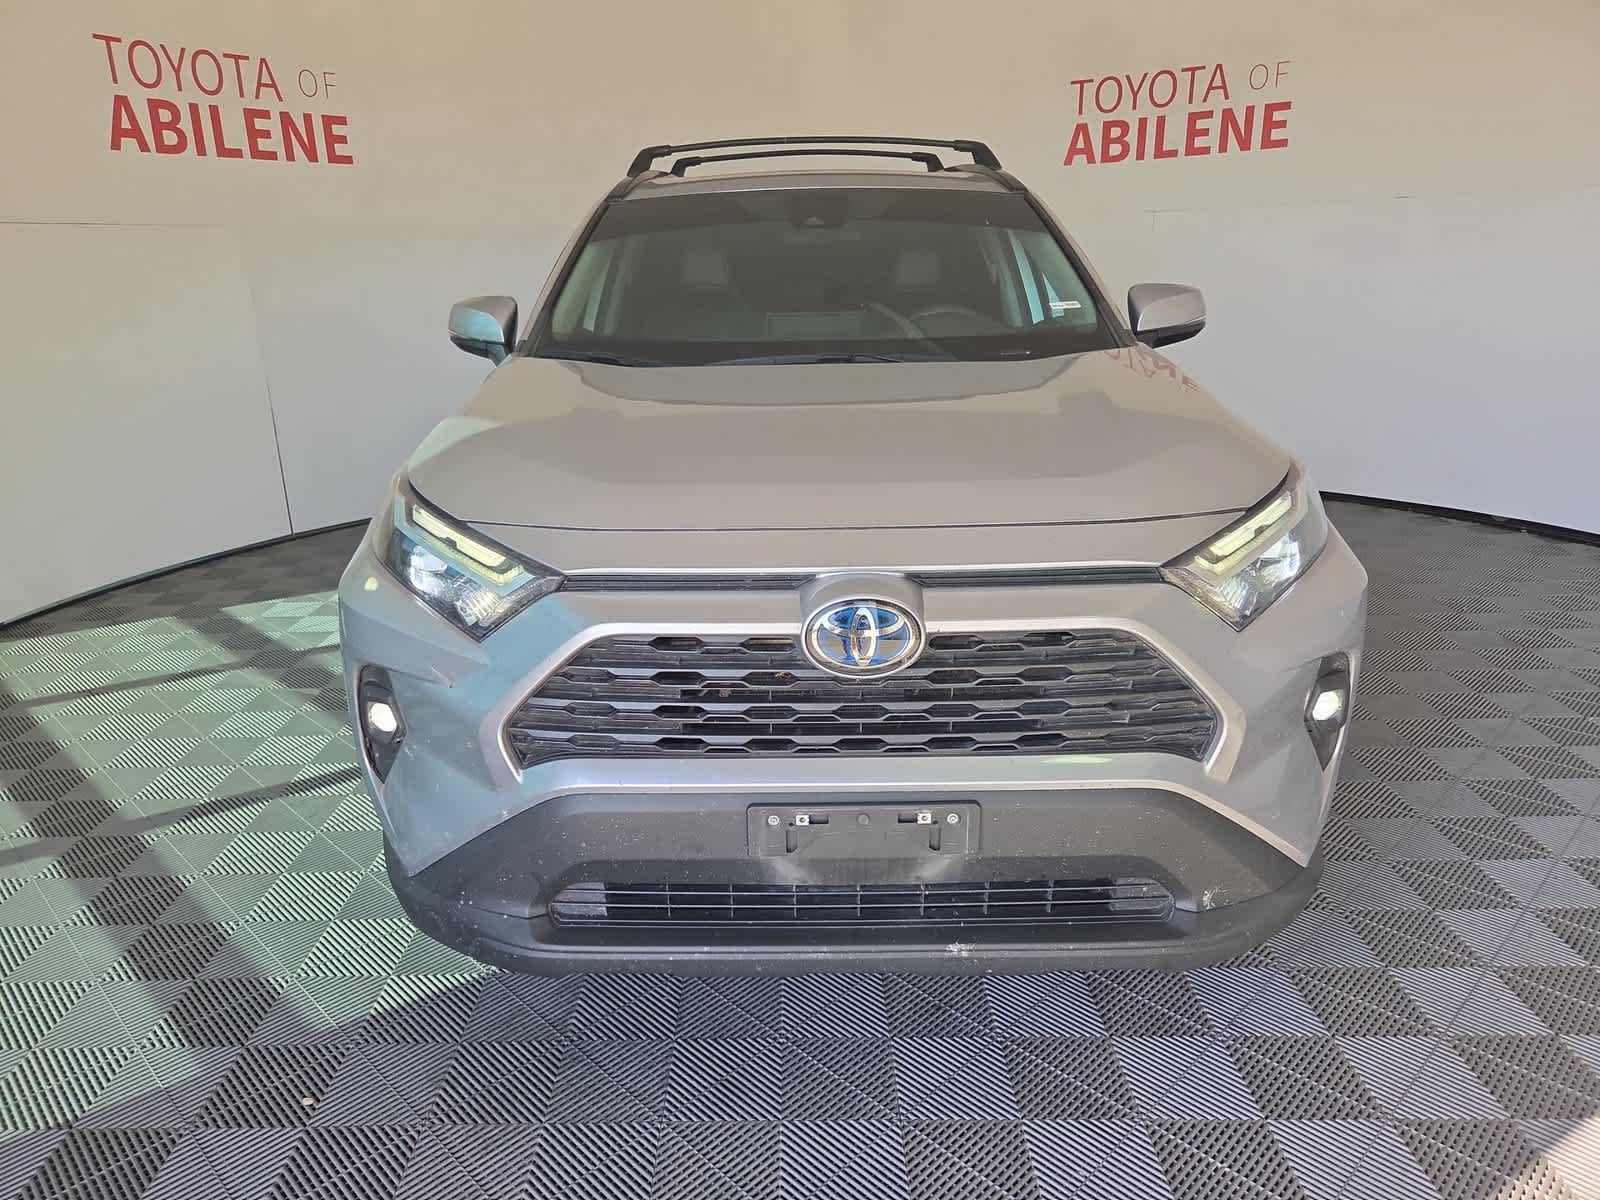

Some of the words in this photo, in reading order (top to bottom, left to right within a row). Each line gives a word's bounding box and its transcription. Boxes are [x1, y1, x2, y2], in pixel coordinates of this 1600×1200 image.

[92, 33, 284, 102] TOYOTA
[297, 68, 336, 99] OF
[1070, 63, 1230, 115] TOYOTA
[1249, 60, 1291, 90] OF
[110, 94, 353, 165] ABILENE
[1063, 101, 1292, 166] ABILENE
